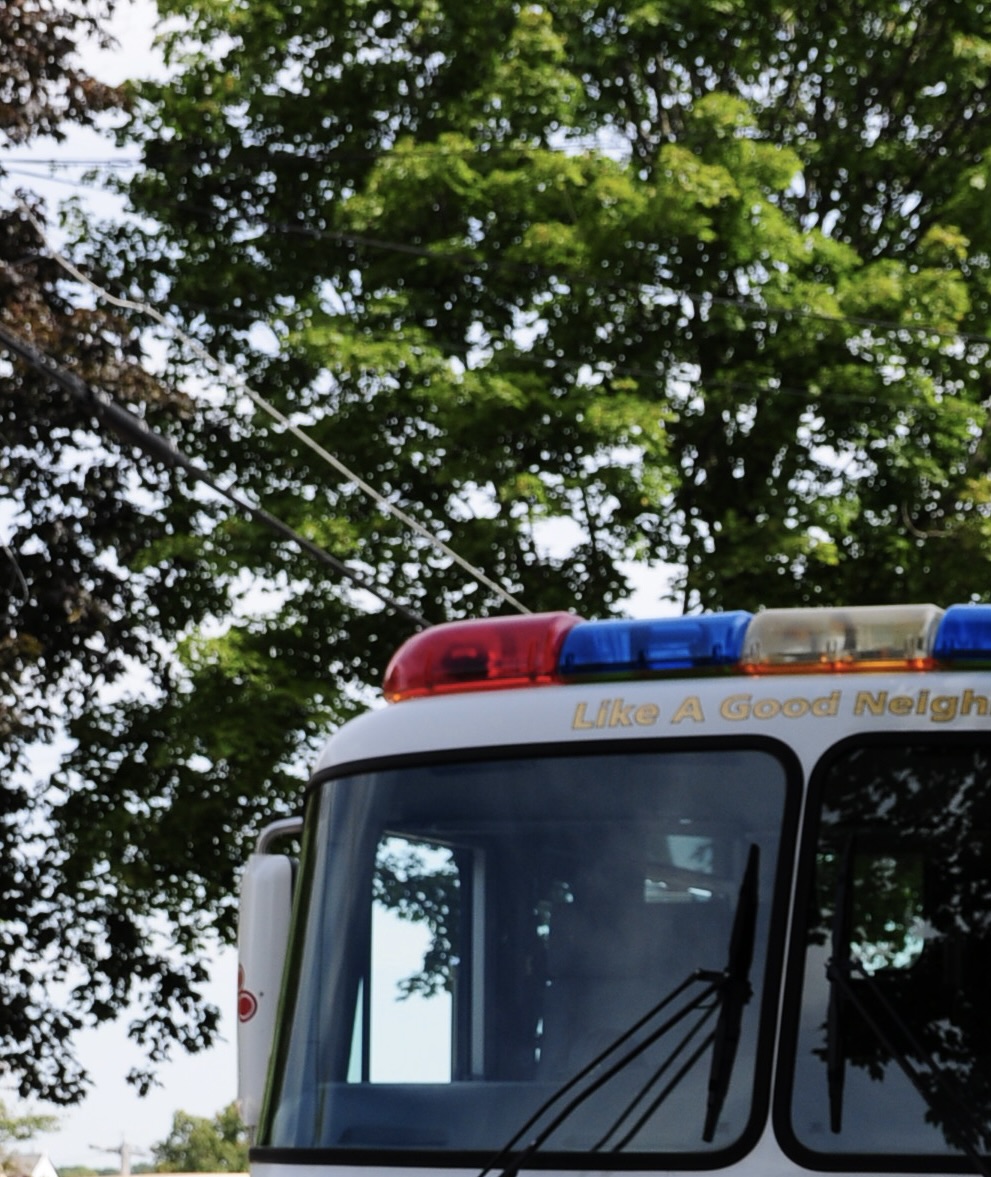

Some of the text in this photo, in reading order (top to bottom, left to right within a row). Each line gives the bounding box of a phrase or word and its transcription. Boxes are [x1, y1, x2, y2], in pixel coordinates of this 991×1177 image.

[571, 698, 661, 731] Like
[670, 695, 705, 725] A
[720, 690, 842, 721] Good
